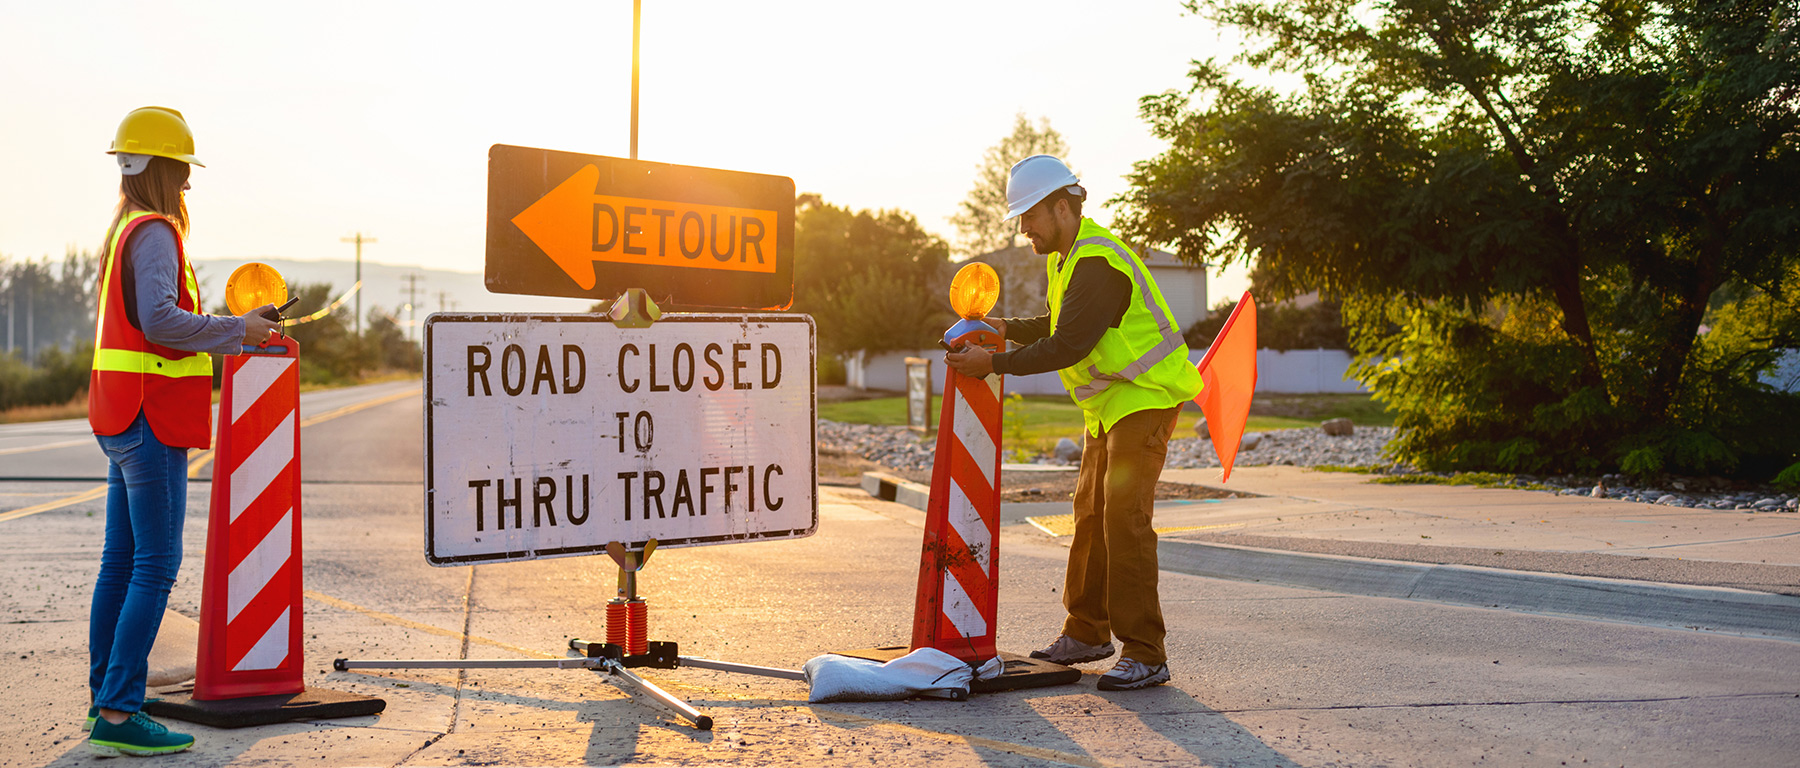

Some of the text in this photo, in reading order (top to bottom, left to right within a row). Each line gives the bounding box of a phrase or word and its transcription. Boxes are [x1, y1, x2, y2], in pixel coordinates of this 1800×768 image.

[592, 203, 765, 264] DETOUR
[467, 342, 782, 397] ROAD CLOSED
[616, 410, 654, 453] TO
[468, 463, 784, 531] THRU TRAFFIC
